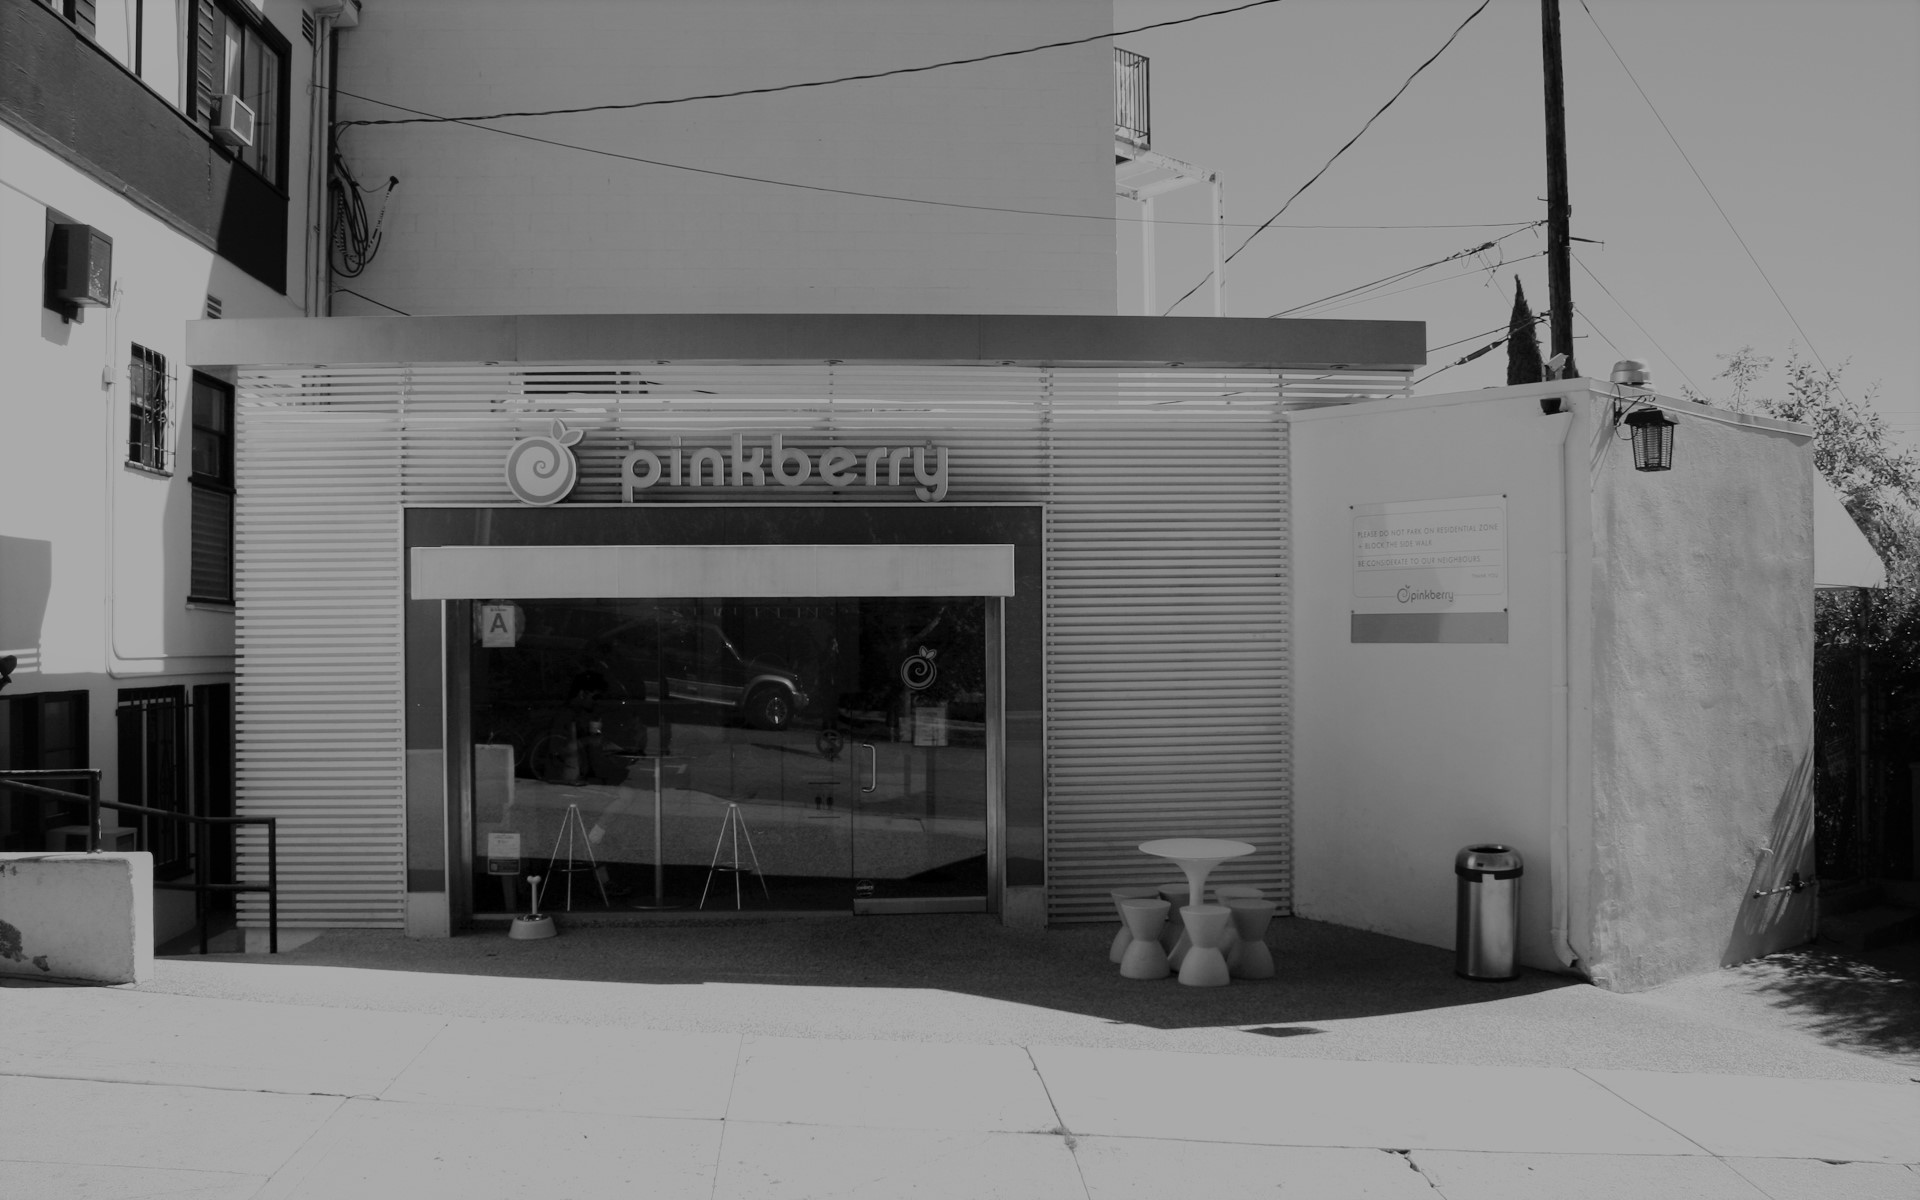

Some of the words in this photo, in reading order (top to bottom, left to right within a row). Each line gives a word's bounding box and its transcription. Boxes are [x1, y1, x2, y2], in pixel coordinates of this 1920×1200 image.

[621, 432, 949, 504] pinkberry
[1357, 530, 1378, 539] PLEASE
[1379, 530, 1390, 538] DO
[1391, 528, 1405, 536] NOT
[1424, 527, 1435, 535] ON
[1436, 525, 1476, 534] RESIDENTIAL
[1479, 523, 1498, 531] ZONE
[1364, 541, 1385, 550] BLOCK
[1386, 541, 1398, 549] THE
[1400, 540, 1413, 548] SIDE
[1415, 539, 1433, 547] WALK
[1357, 560, 1366, 569] BE
[1366, 558, 1408, 567] CONSIDERATE
[1411, 557, 1420, 565] TO
[1421, 557, 1435, 565] OUR
[1437, 555, 1481, 564] NEIGHBOURS
[1410, 588, 1454, 603] pinkberry
[490, 612, 508, 633] A
